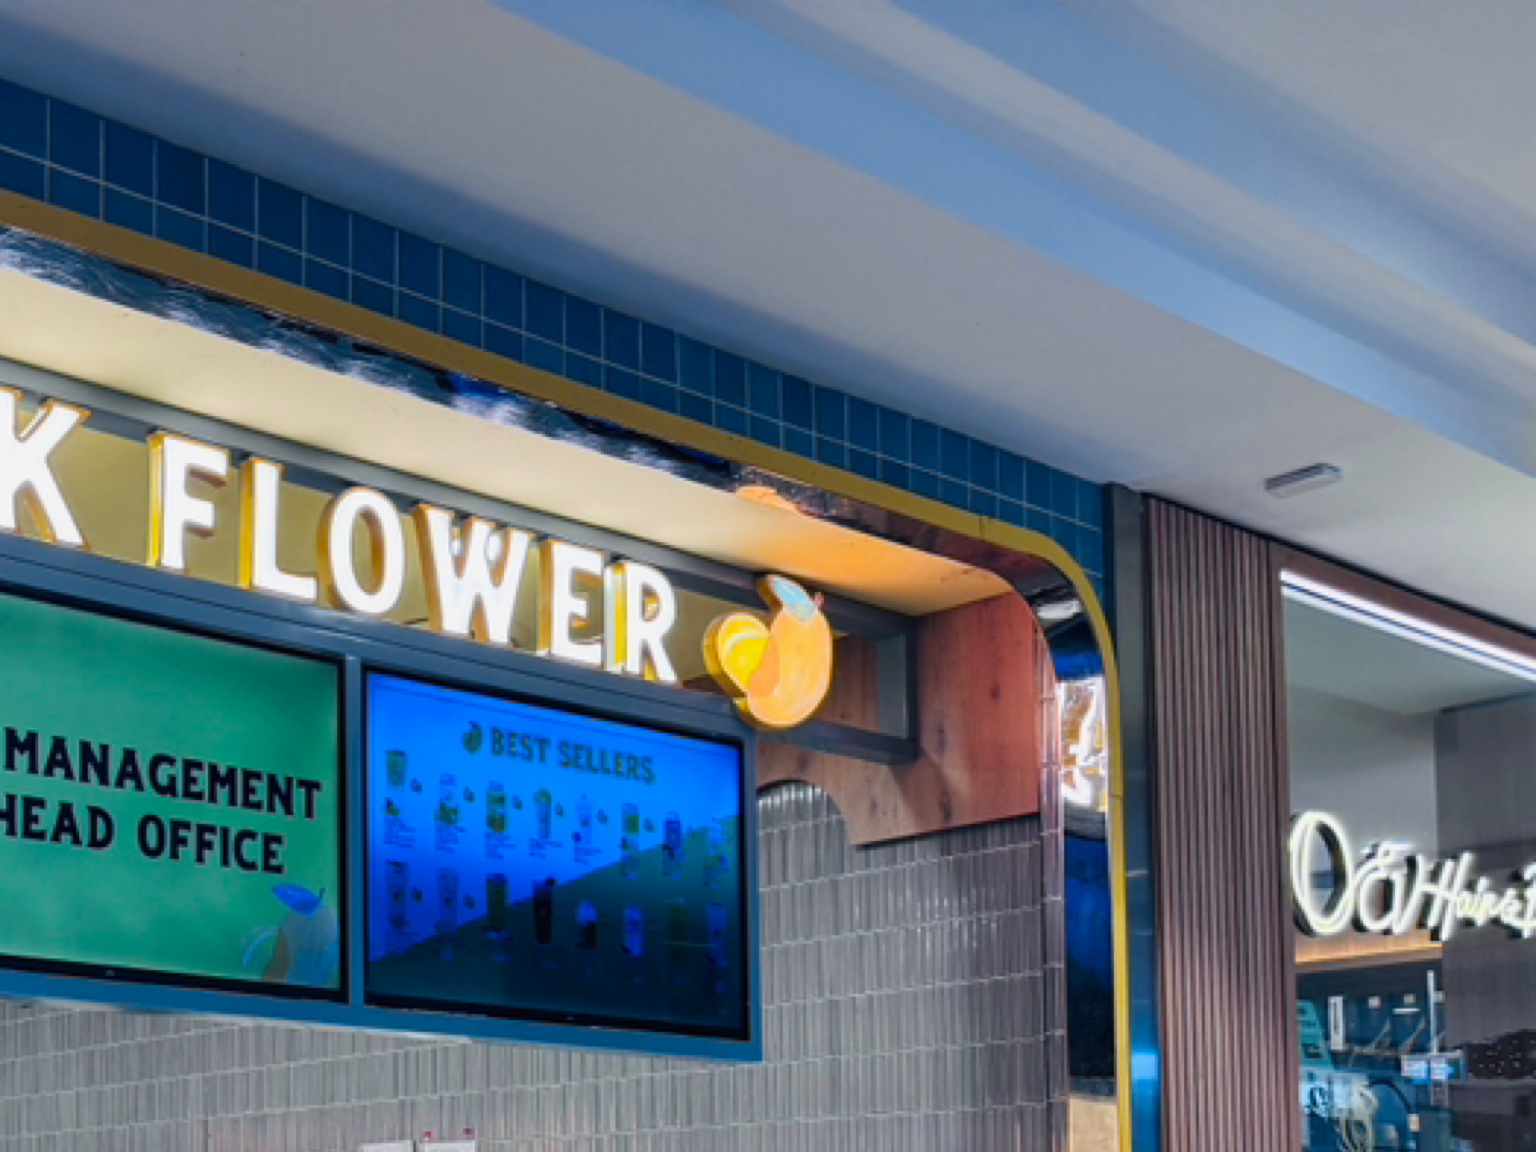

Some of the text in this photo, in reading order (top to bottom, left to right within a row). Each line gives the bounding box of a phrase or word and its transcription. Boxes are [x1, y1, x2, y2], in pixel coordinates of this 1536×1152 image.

[147, 431, 680, 685] FLOWER
[4, 726, 322, 820] MANAGEMENT
[490, 726, 657, 785] BEST SELLERS
[136, 813, 286, 875] OFFICE
